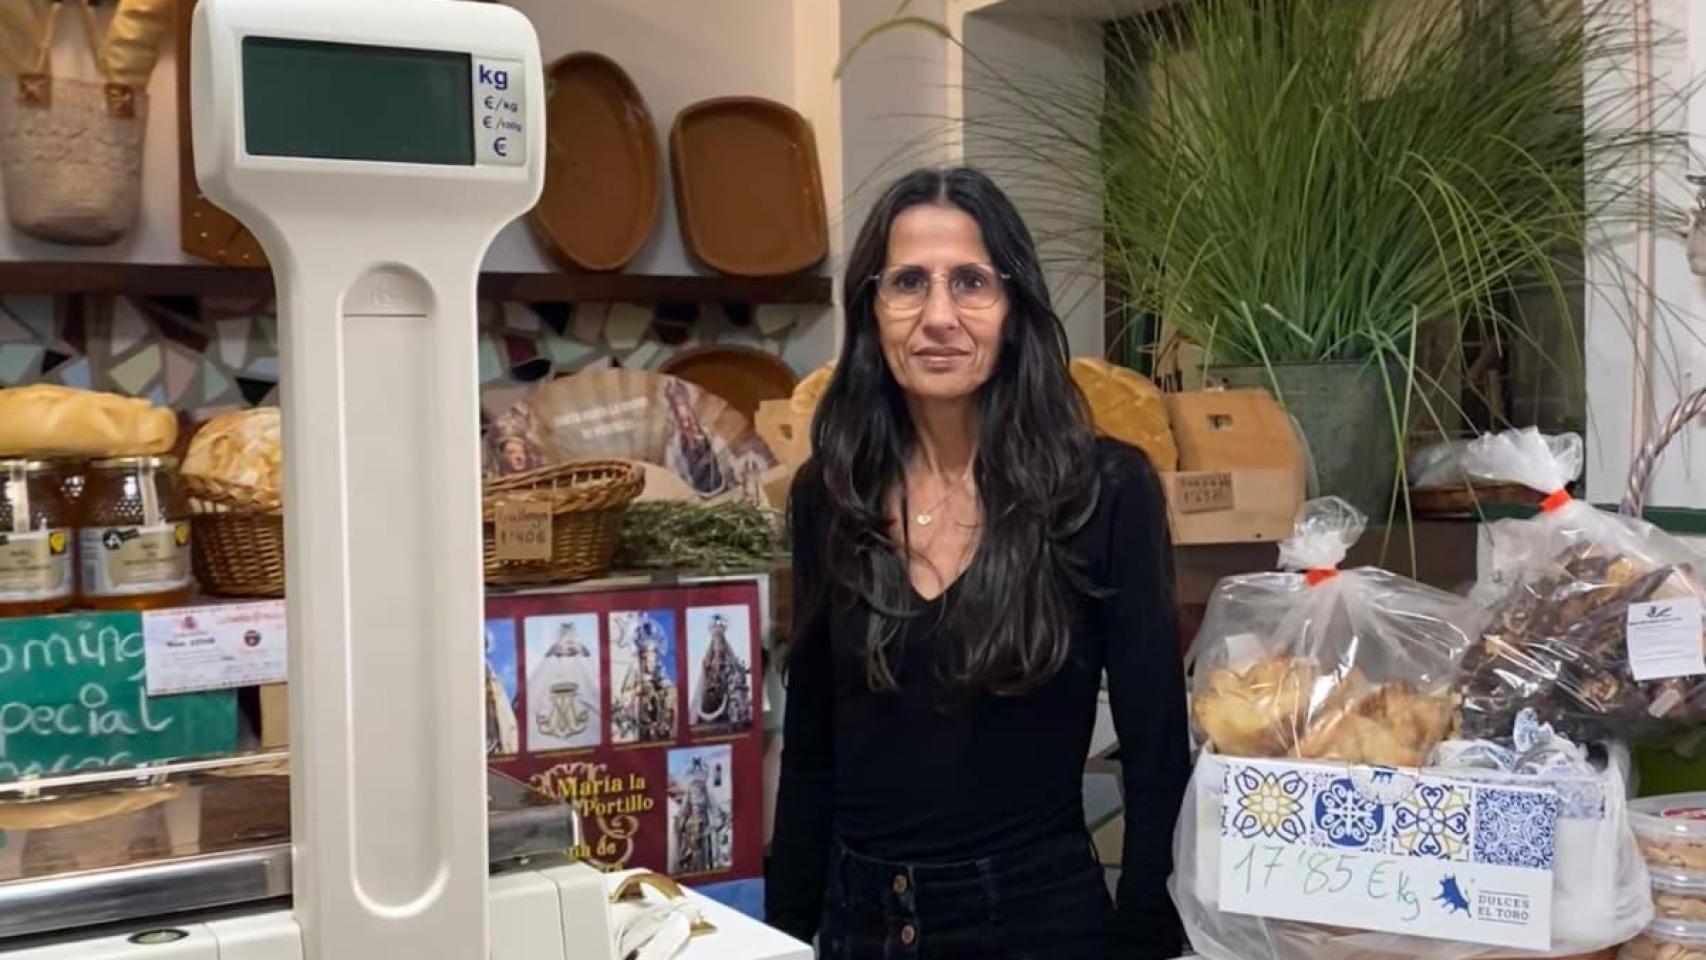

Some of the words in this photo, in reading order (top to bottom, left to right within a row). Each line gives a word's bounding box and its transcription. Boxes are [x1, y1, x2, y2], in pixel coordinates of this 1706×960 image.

[479, 64, 508, 91] kg
[493, 136, 507, 157] €
[629, 773, 645, 791] la
[580, 794, 654, 817] Portillo
[1478, 895, 1531, 908] DULCES
[1478, 906, 1493, 917] EL
[1495, 908, 1529, 921] TORO
